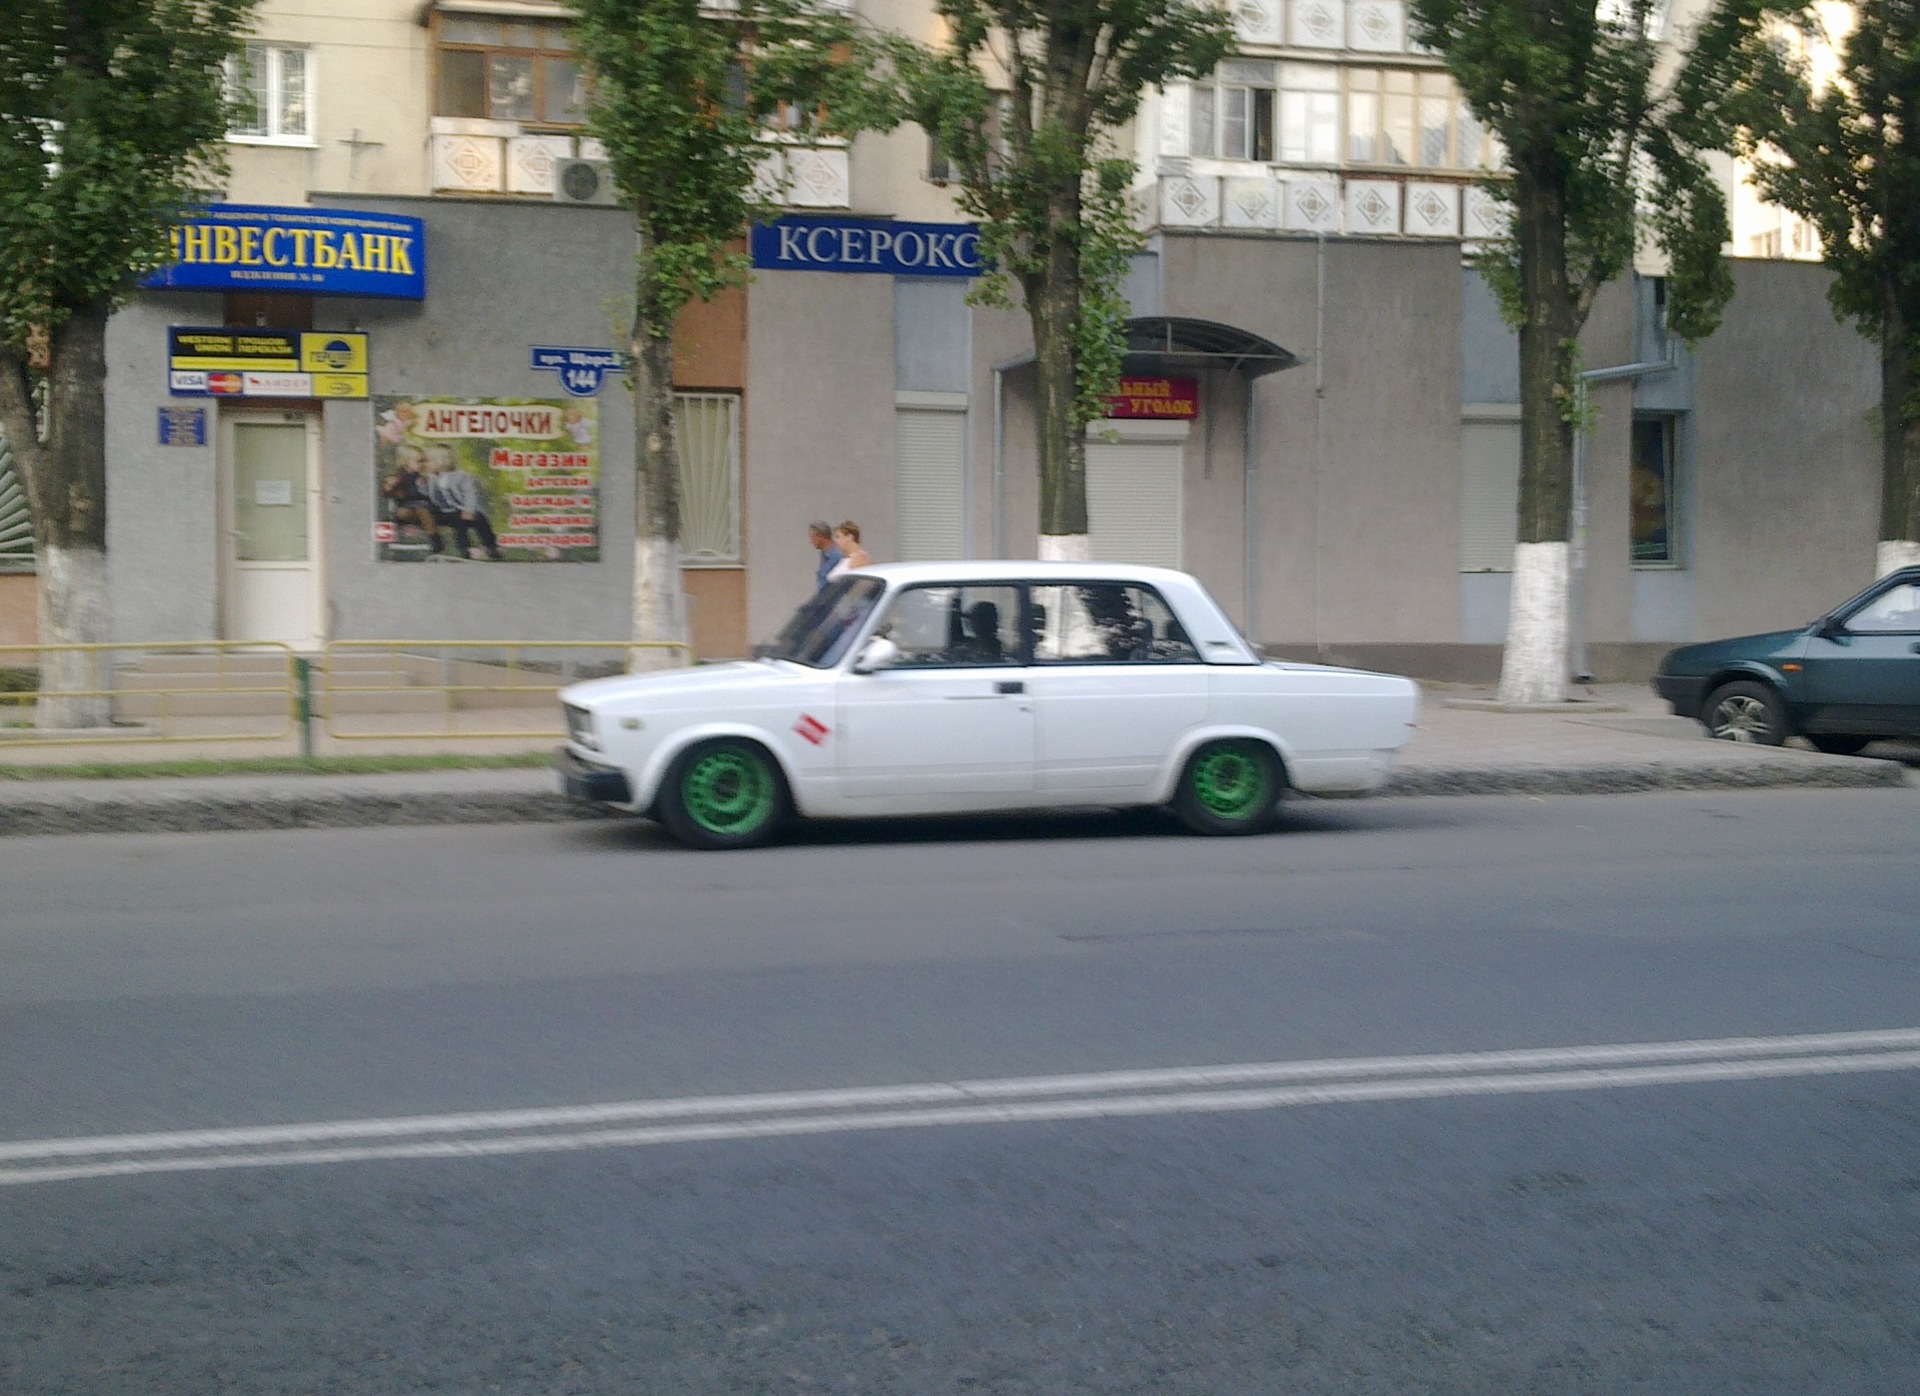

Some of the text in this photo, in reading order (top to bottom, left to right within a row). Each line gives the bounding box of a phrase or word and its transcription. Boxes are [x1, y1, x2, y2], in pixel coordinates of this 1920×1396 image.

[777, 225, 981, 268] КСЕРОКС
[174, 375, 203, 386] VISA
[567, 369, 596, 388] 144
[426, 409, 551, 433] АНГЕЛОЧКИ
[493, 450, 589, 467] Магазин
